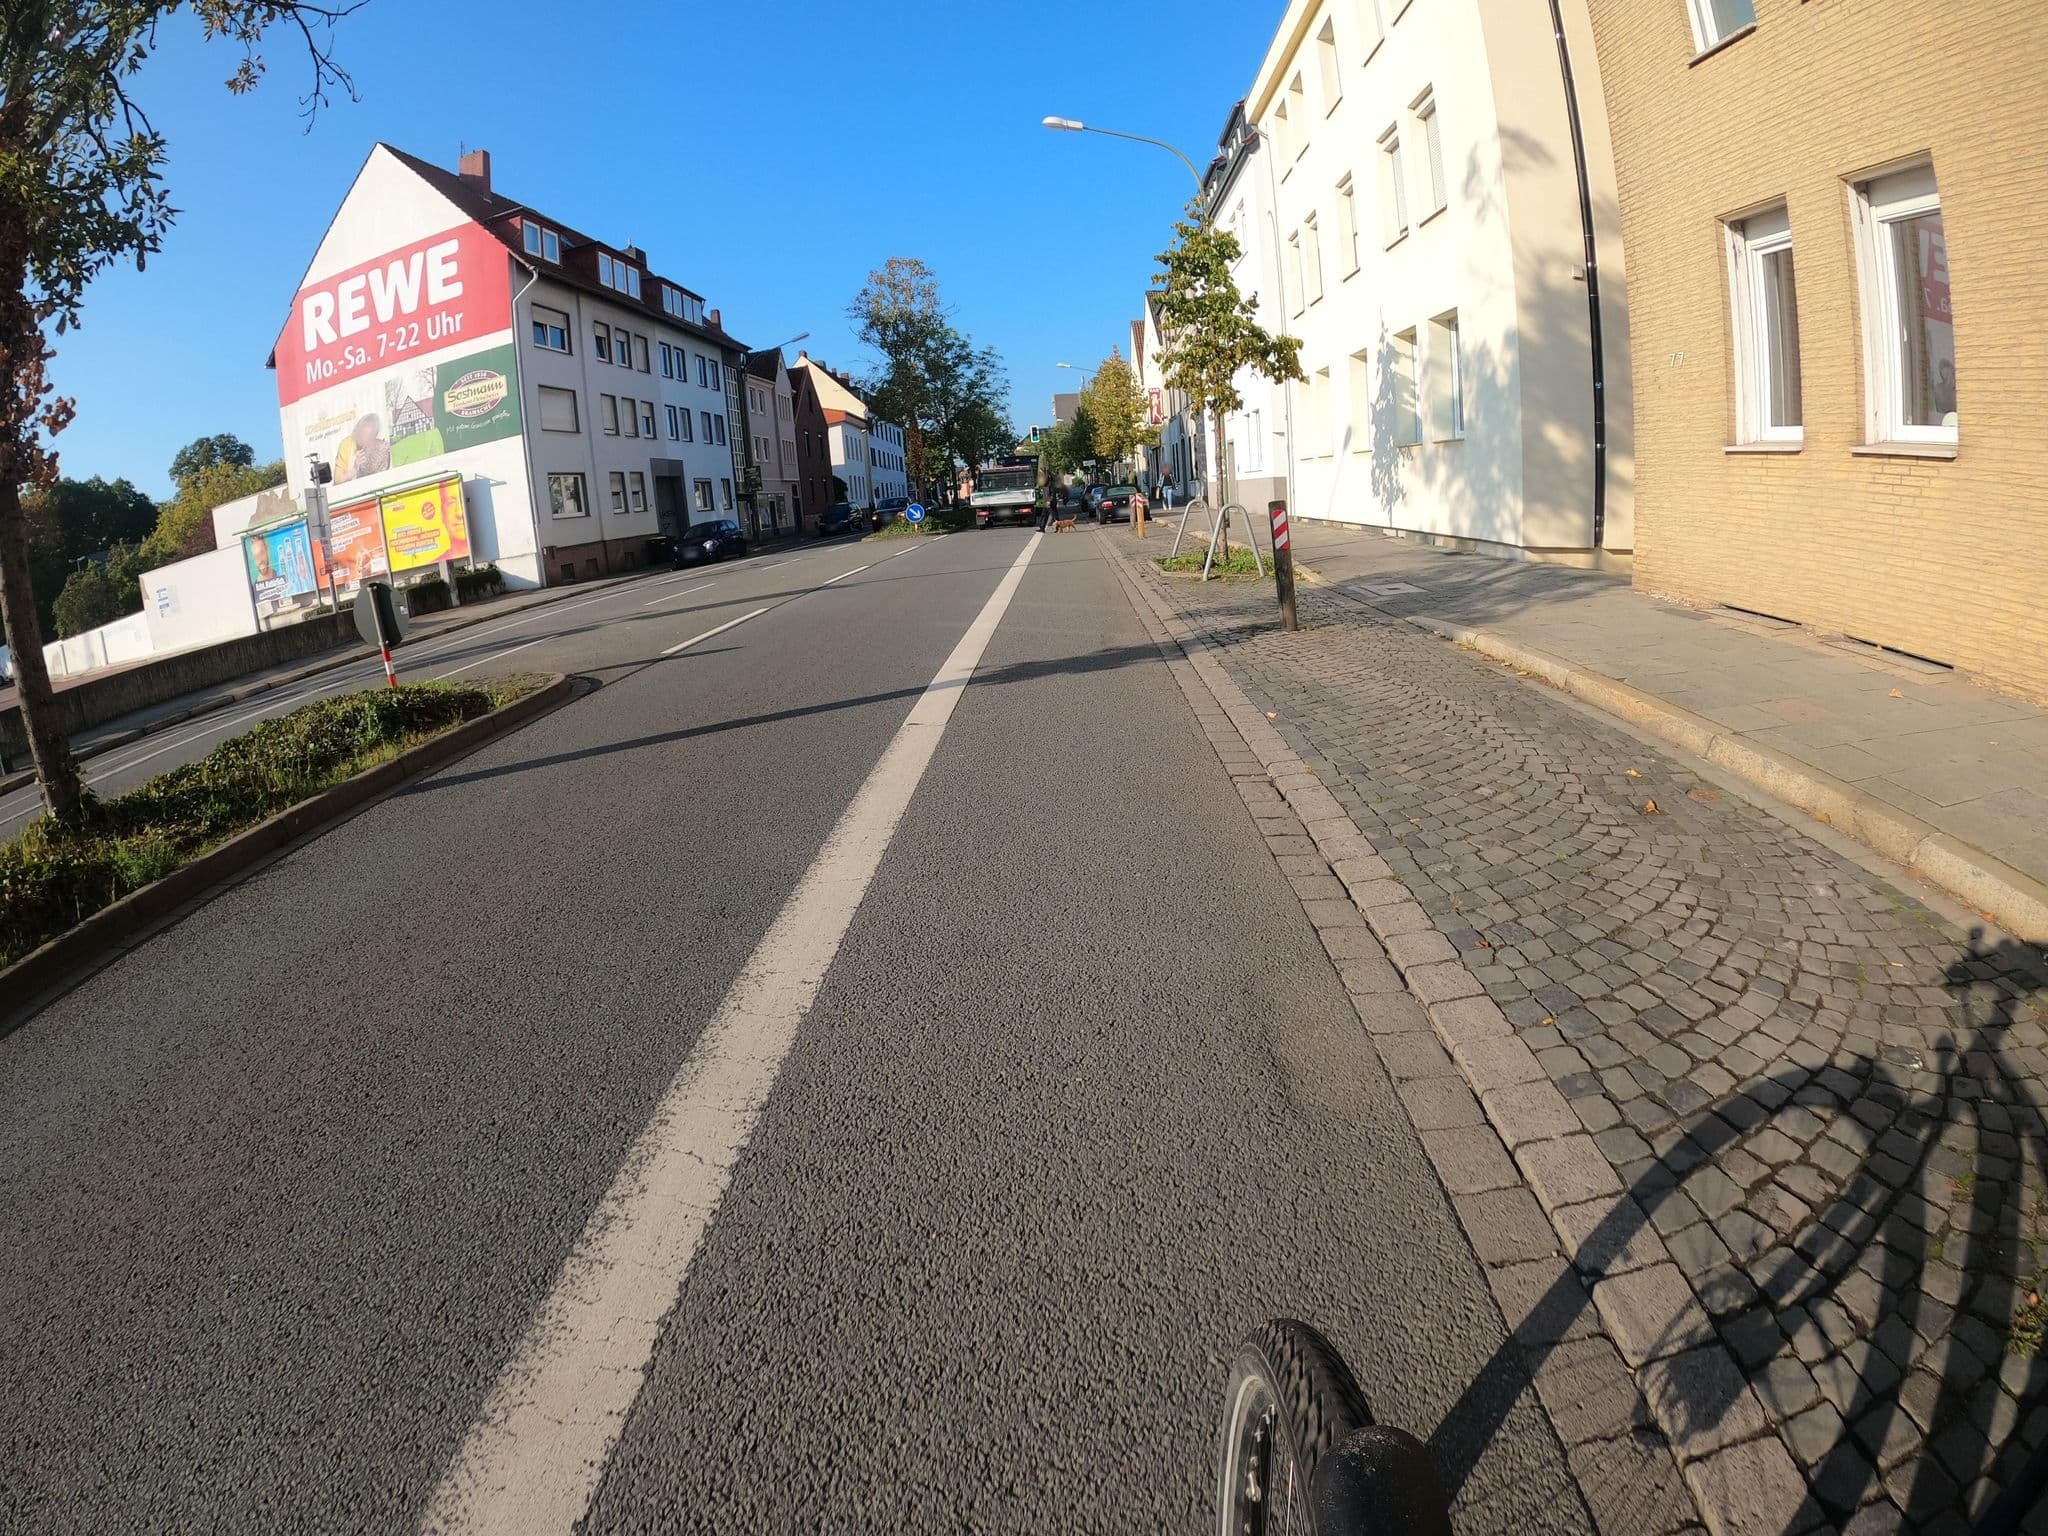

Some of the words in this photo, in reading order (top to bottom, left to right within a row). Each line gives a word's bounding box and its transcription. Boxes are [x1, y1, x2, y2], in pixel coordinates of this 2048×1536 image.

[302, 238, 464, 353] REWE
[305, 345, 372, 385] Mo.-Sa.
[376, 322, 420, 358] 7-22
[426, 311, 464, 341] Uhr
